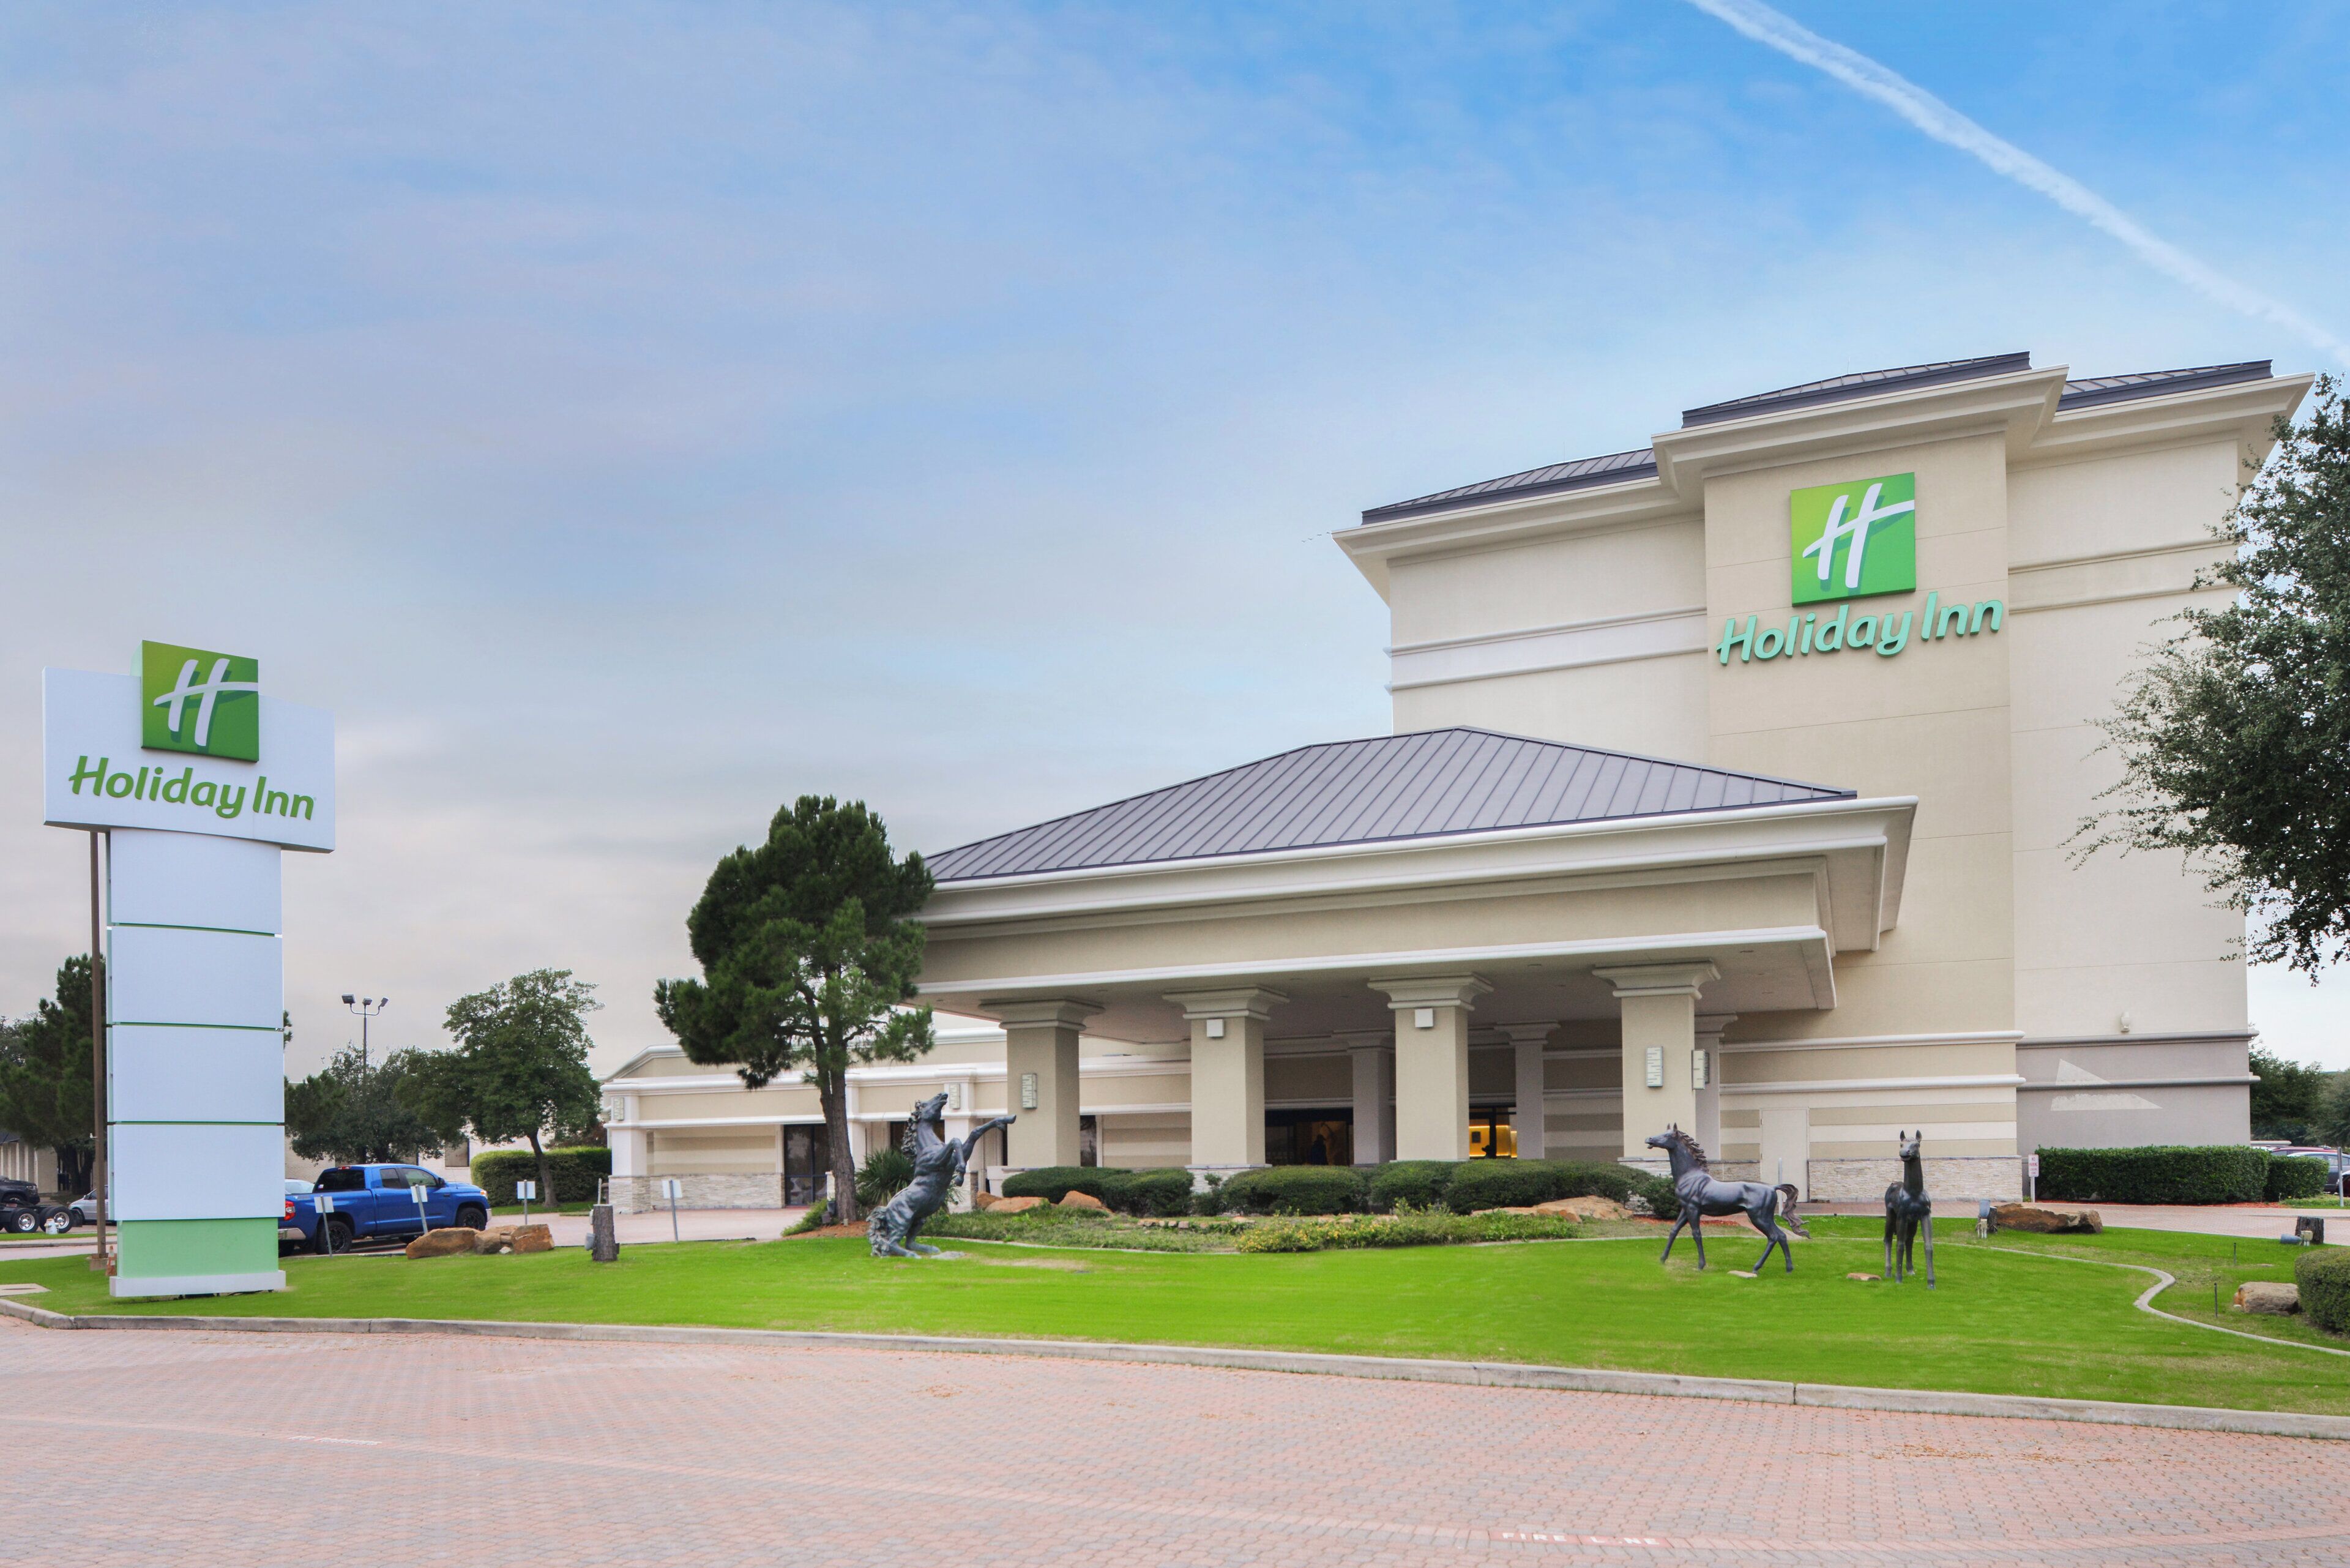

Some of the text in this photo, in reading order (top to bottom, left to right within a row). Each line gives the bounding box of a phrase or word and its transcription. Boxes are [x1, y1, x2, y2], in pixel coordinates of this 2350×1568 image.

[1802, 482, 1915, 588] H
[1716, 591, 2004, 666] Holiday Inn
[153, 658, 258, 747] H
[69, 755, 315, 820] Holiday Inn
[1502, 1532, 1660, 1545] FIRE LNE
